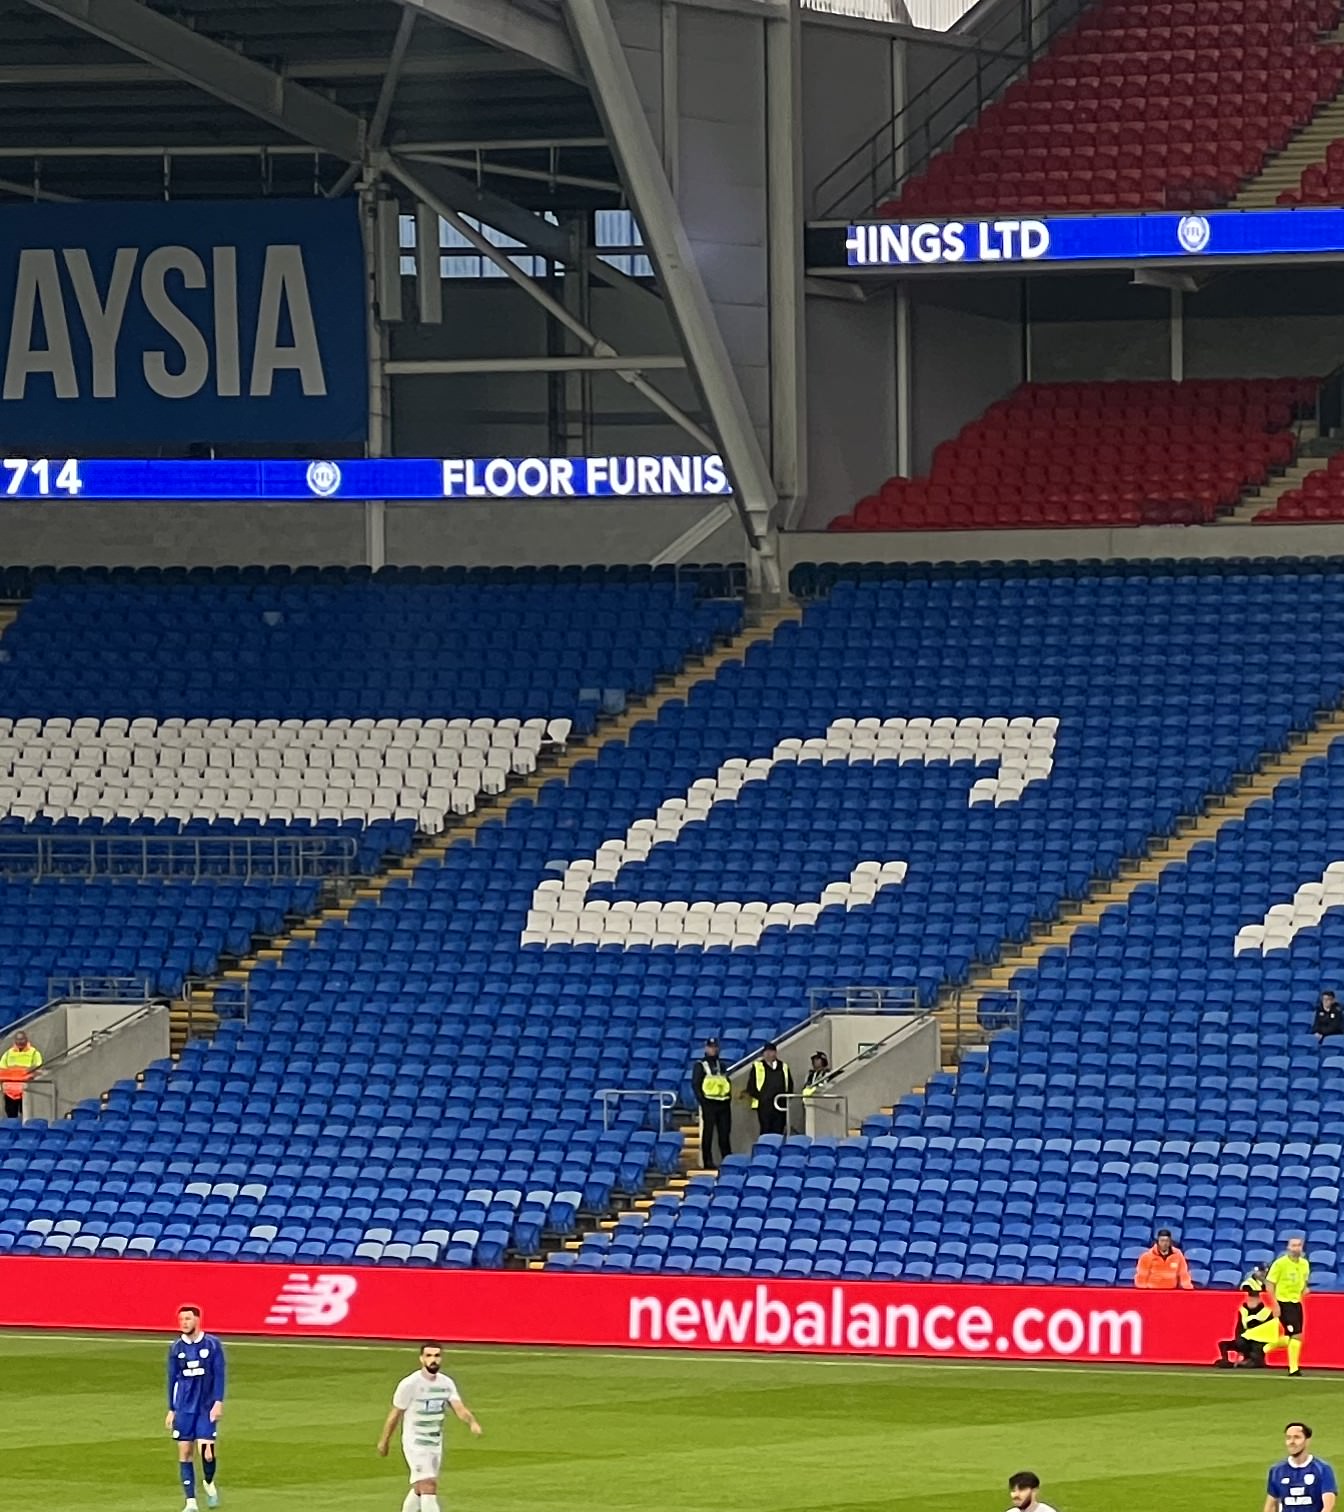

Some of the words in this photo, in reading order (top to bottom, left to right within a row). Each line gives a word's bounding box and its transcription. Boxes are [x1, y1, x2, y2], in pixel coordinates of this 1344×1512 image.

[978, 219, 1050, 260] LTD
[3, 245, 327, 399] AYSIA
[3, 459, 82, 495] 714
[443, 458, 574, 496] FLOOR
[586, 455, 733, 495] FURNIS
[628, 1284, 1142, 1356] newbalance.com
